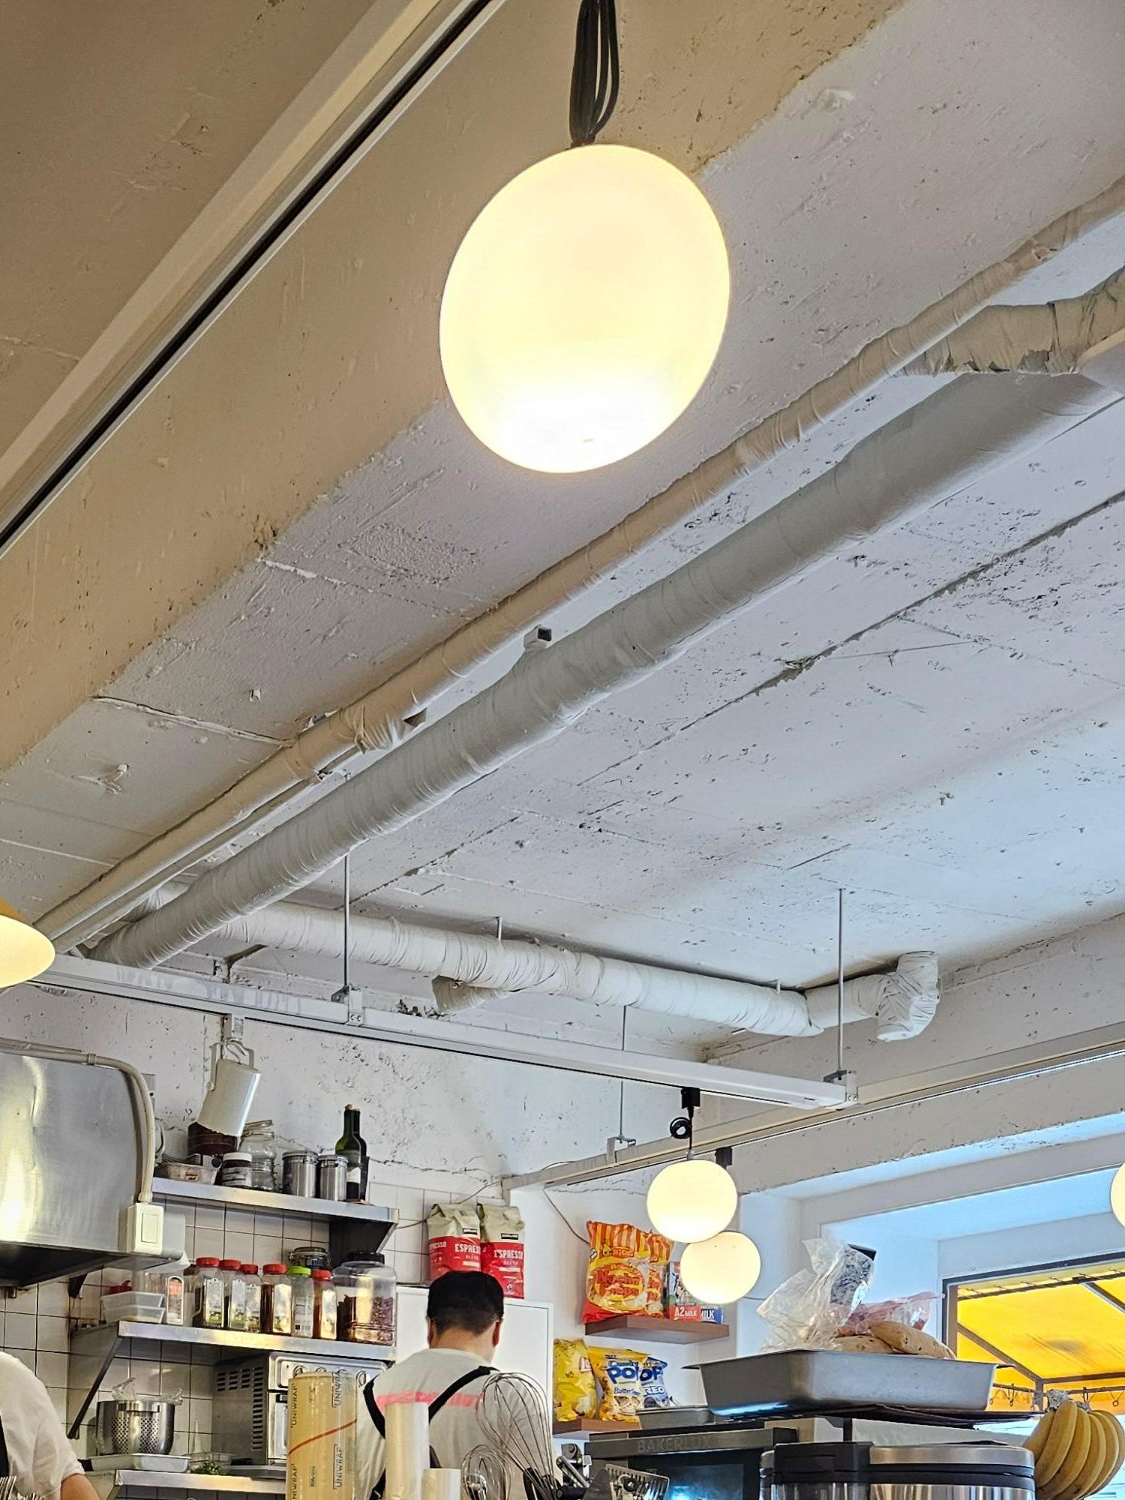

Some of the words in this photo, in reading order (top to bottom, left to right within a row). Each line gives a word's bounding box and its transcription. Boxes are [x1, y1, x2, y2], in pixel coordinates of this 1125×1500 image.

[674, 1306, 685, 1317] A2
[640, 1366, 663, 1382] OP
[643, 1385, 666, 1396] REO
[637, 1435, 711, 1453] BAKERLUX
[335, 1447, 343, 1488] UNIWRAP
